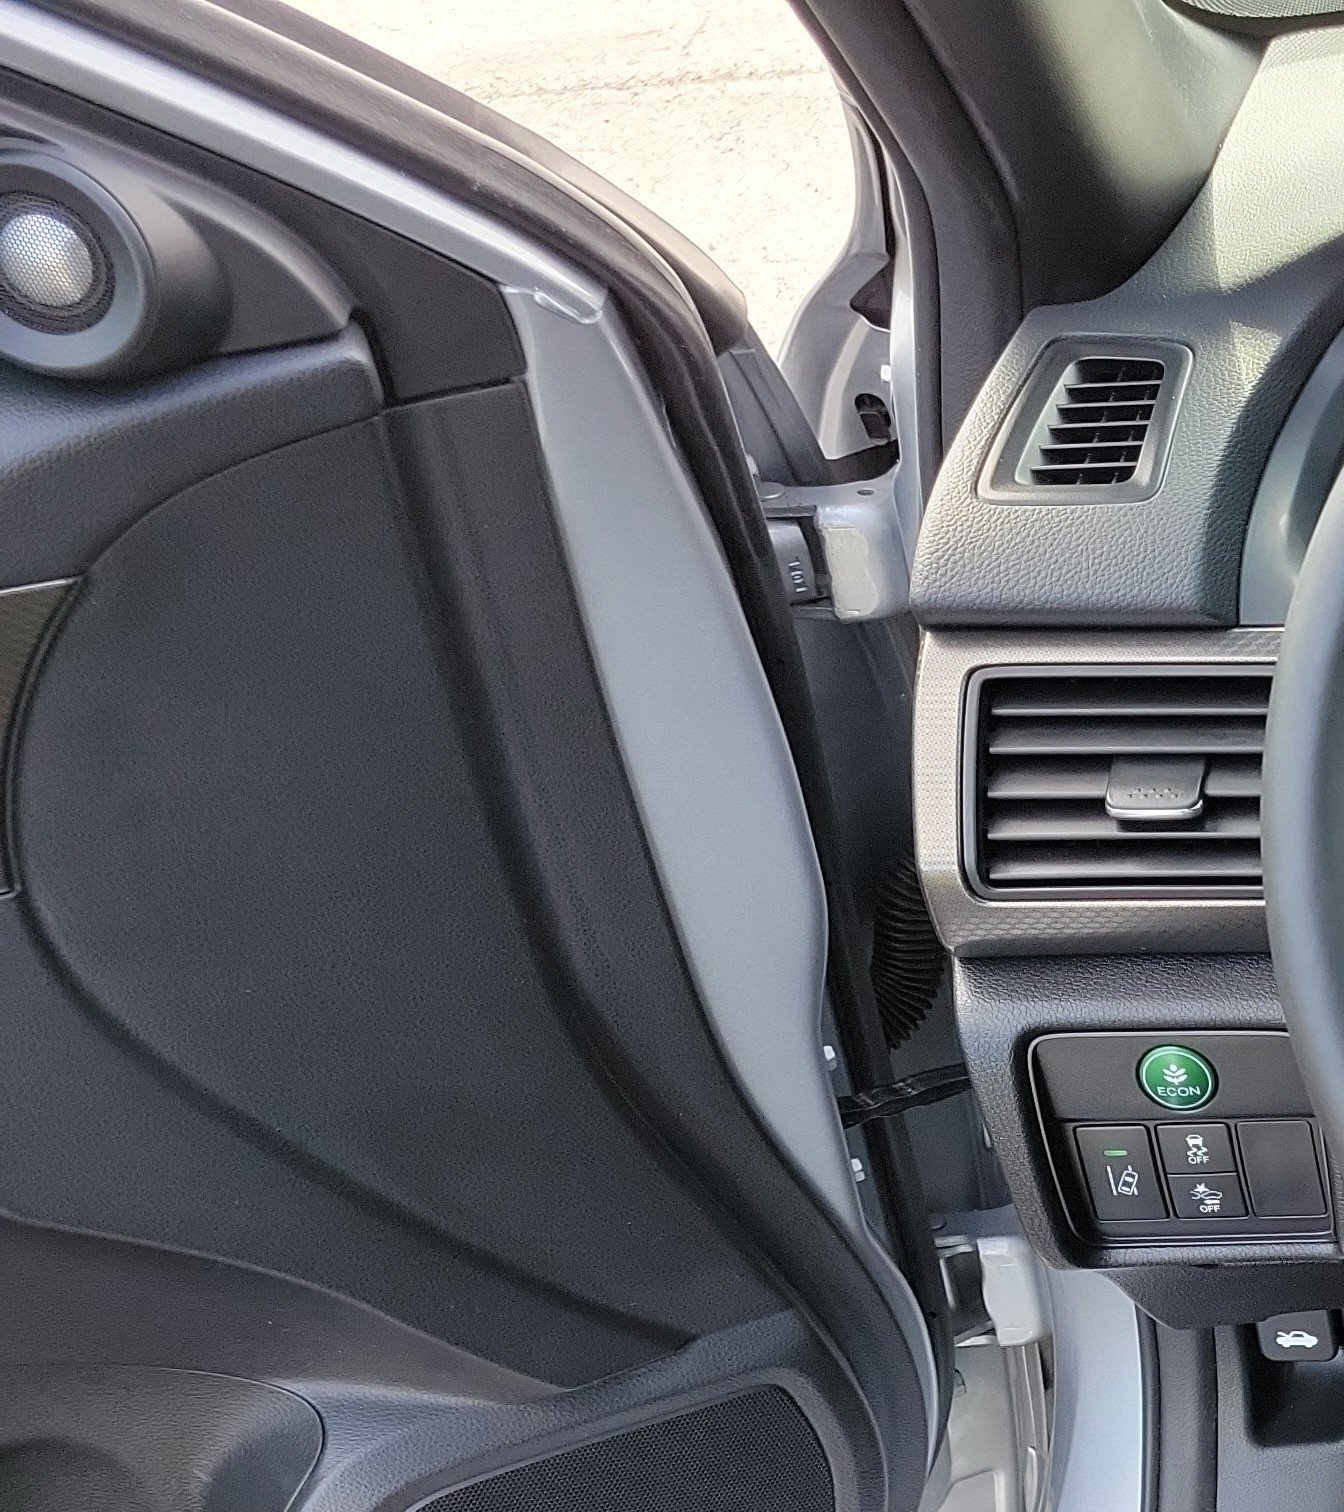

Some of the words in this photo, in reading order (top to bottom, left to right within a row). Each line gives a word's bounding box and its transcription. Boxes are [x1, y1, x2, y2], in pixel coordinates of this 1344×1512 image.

[1157, 1085, 1201, 1098] ECON
[1187, 1155, 1210, 1165] OFF
[1199, 1204, 1221, 1214] OFF
